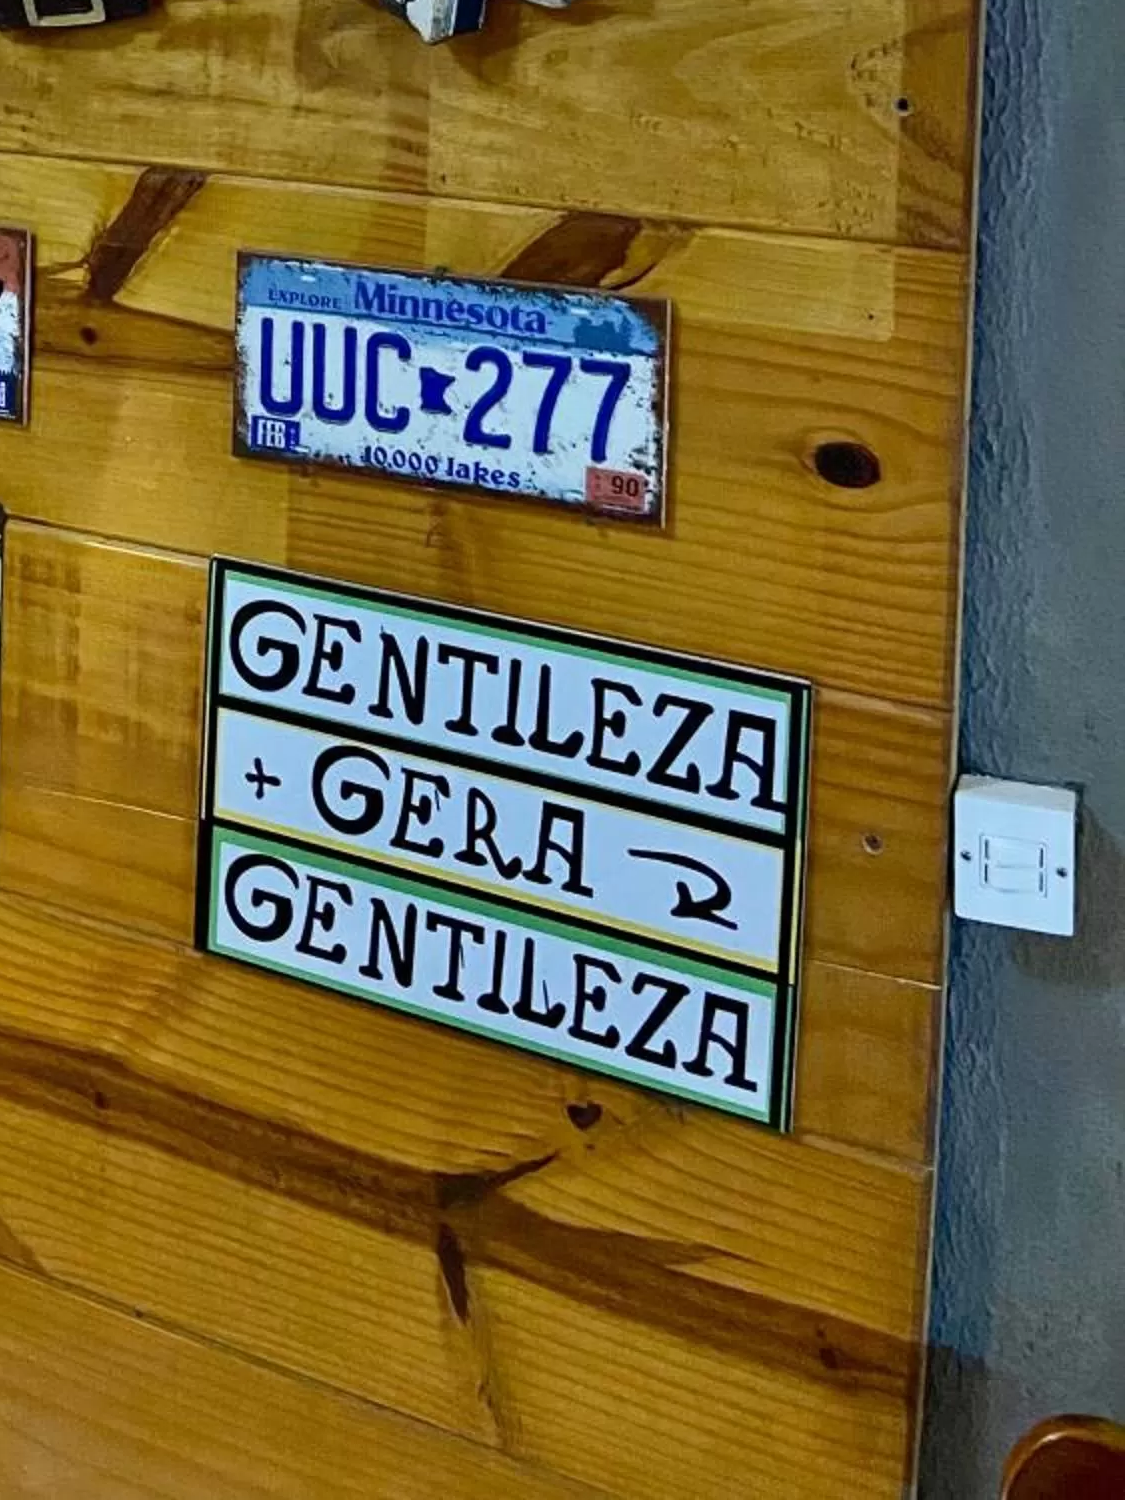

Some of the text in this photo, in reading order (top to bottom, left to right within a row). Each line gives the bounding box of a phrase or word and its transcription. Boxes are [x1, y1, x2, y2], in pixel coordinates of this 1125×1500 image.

[268, 281, 550, 337] EXPLORE Minnesota
[256, 419, 286, 449] FEB
[259, 316, 632, 464] UUC 277
[444, 456, 521, 489] lakes
[611, 475, 640, 498] 90
[229, 597, 789, 814] GENTILEZA
[311, 744, 594, 899] GERA
[223, 852, 760, 1093] GENTILEZA
